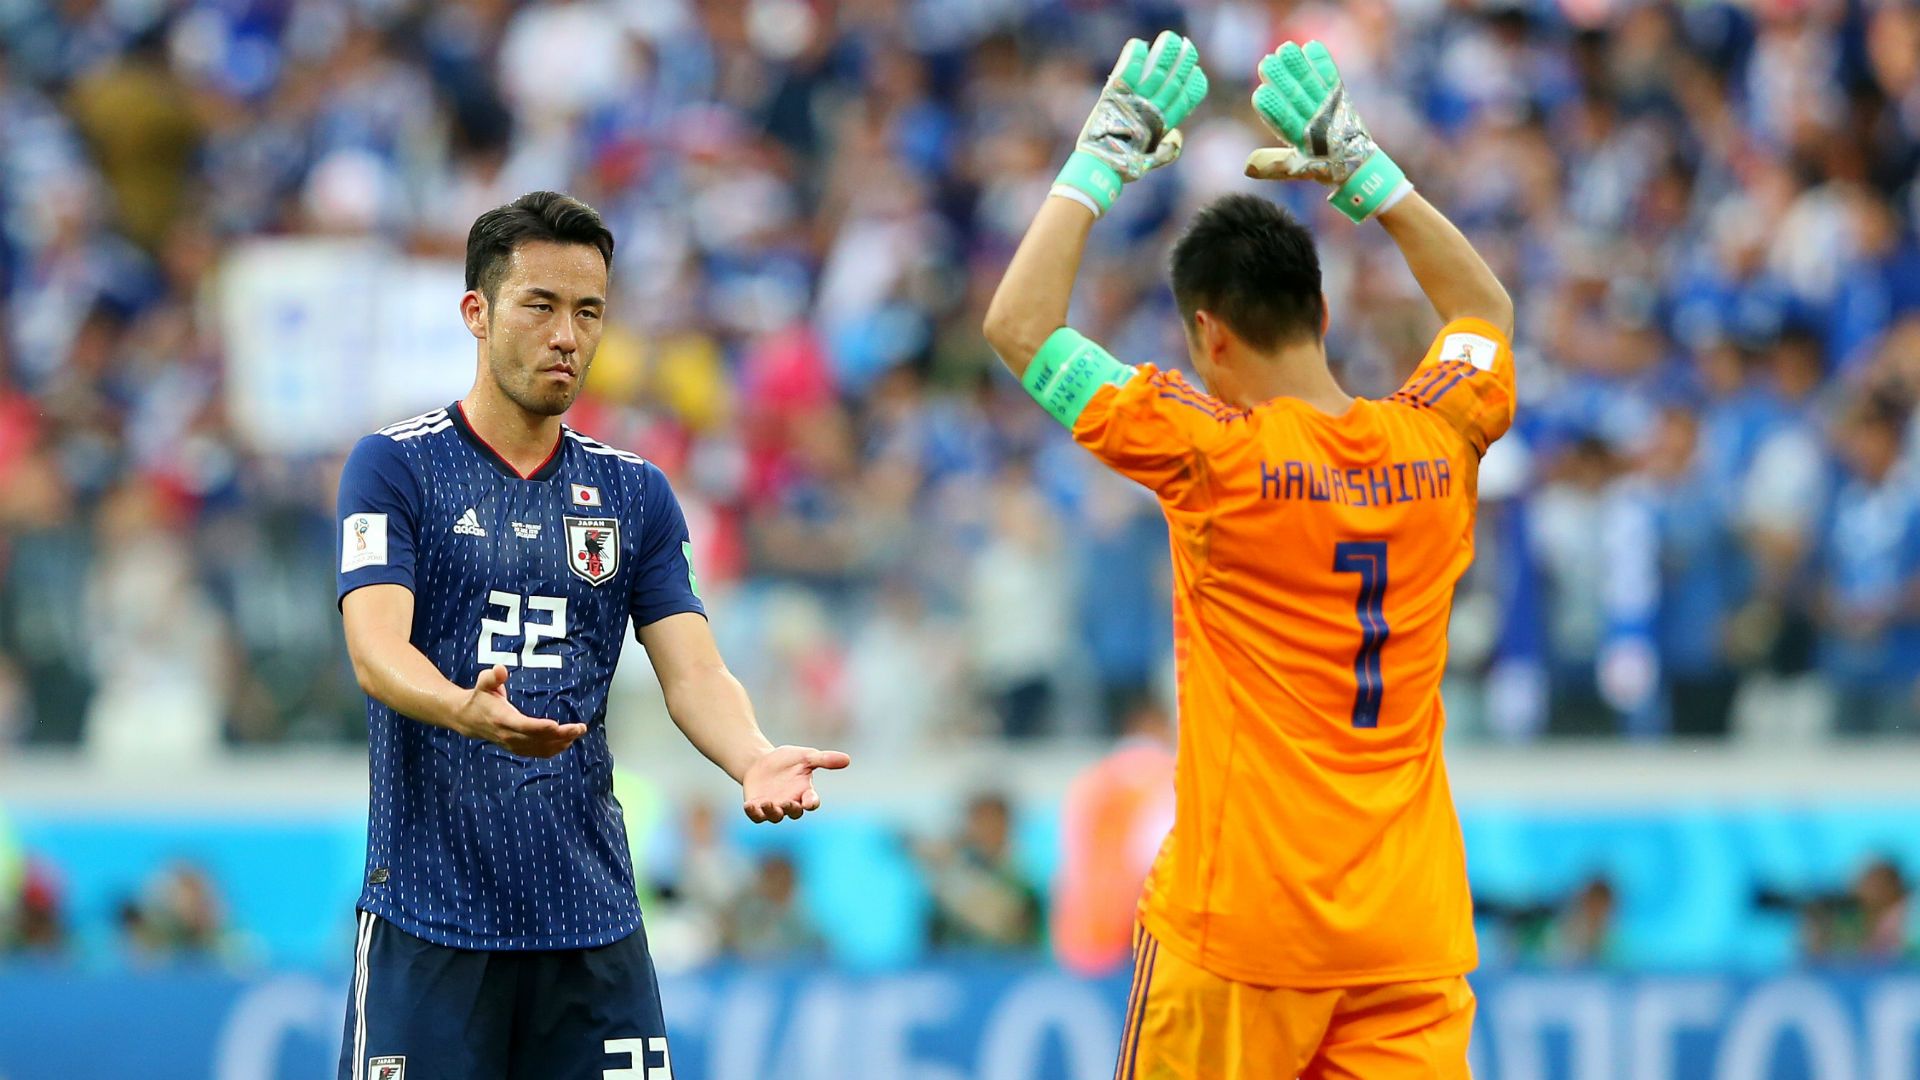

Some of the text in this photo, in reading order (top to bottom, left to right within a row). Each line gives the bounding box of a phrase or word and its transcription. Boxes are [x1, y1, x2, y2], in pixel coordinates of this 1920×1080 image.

[1260, 458, 1451, 507] KAWASHIMA
[453, 524, 486, 537] adidas
[584, 560, 605, 573] JFA
[477, 589, 567, 669] 22
